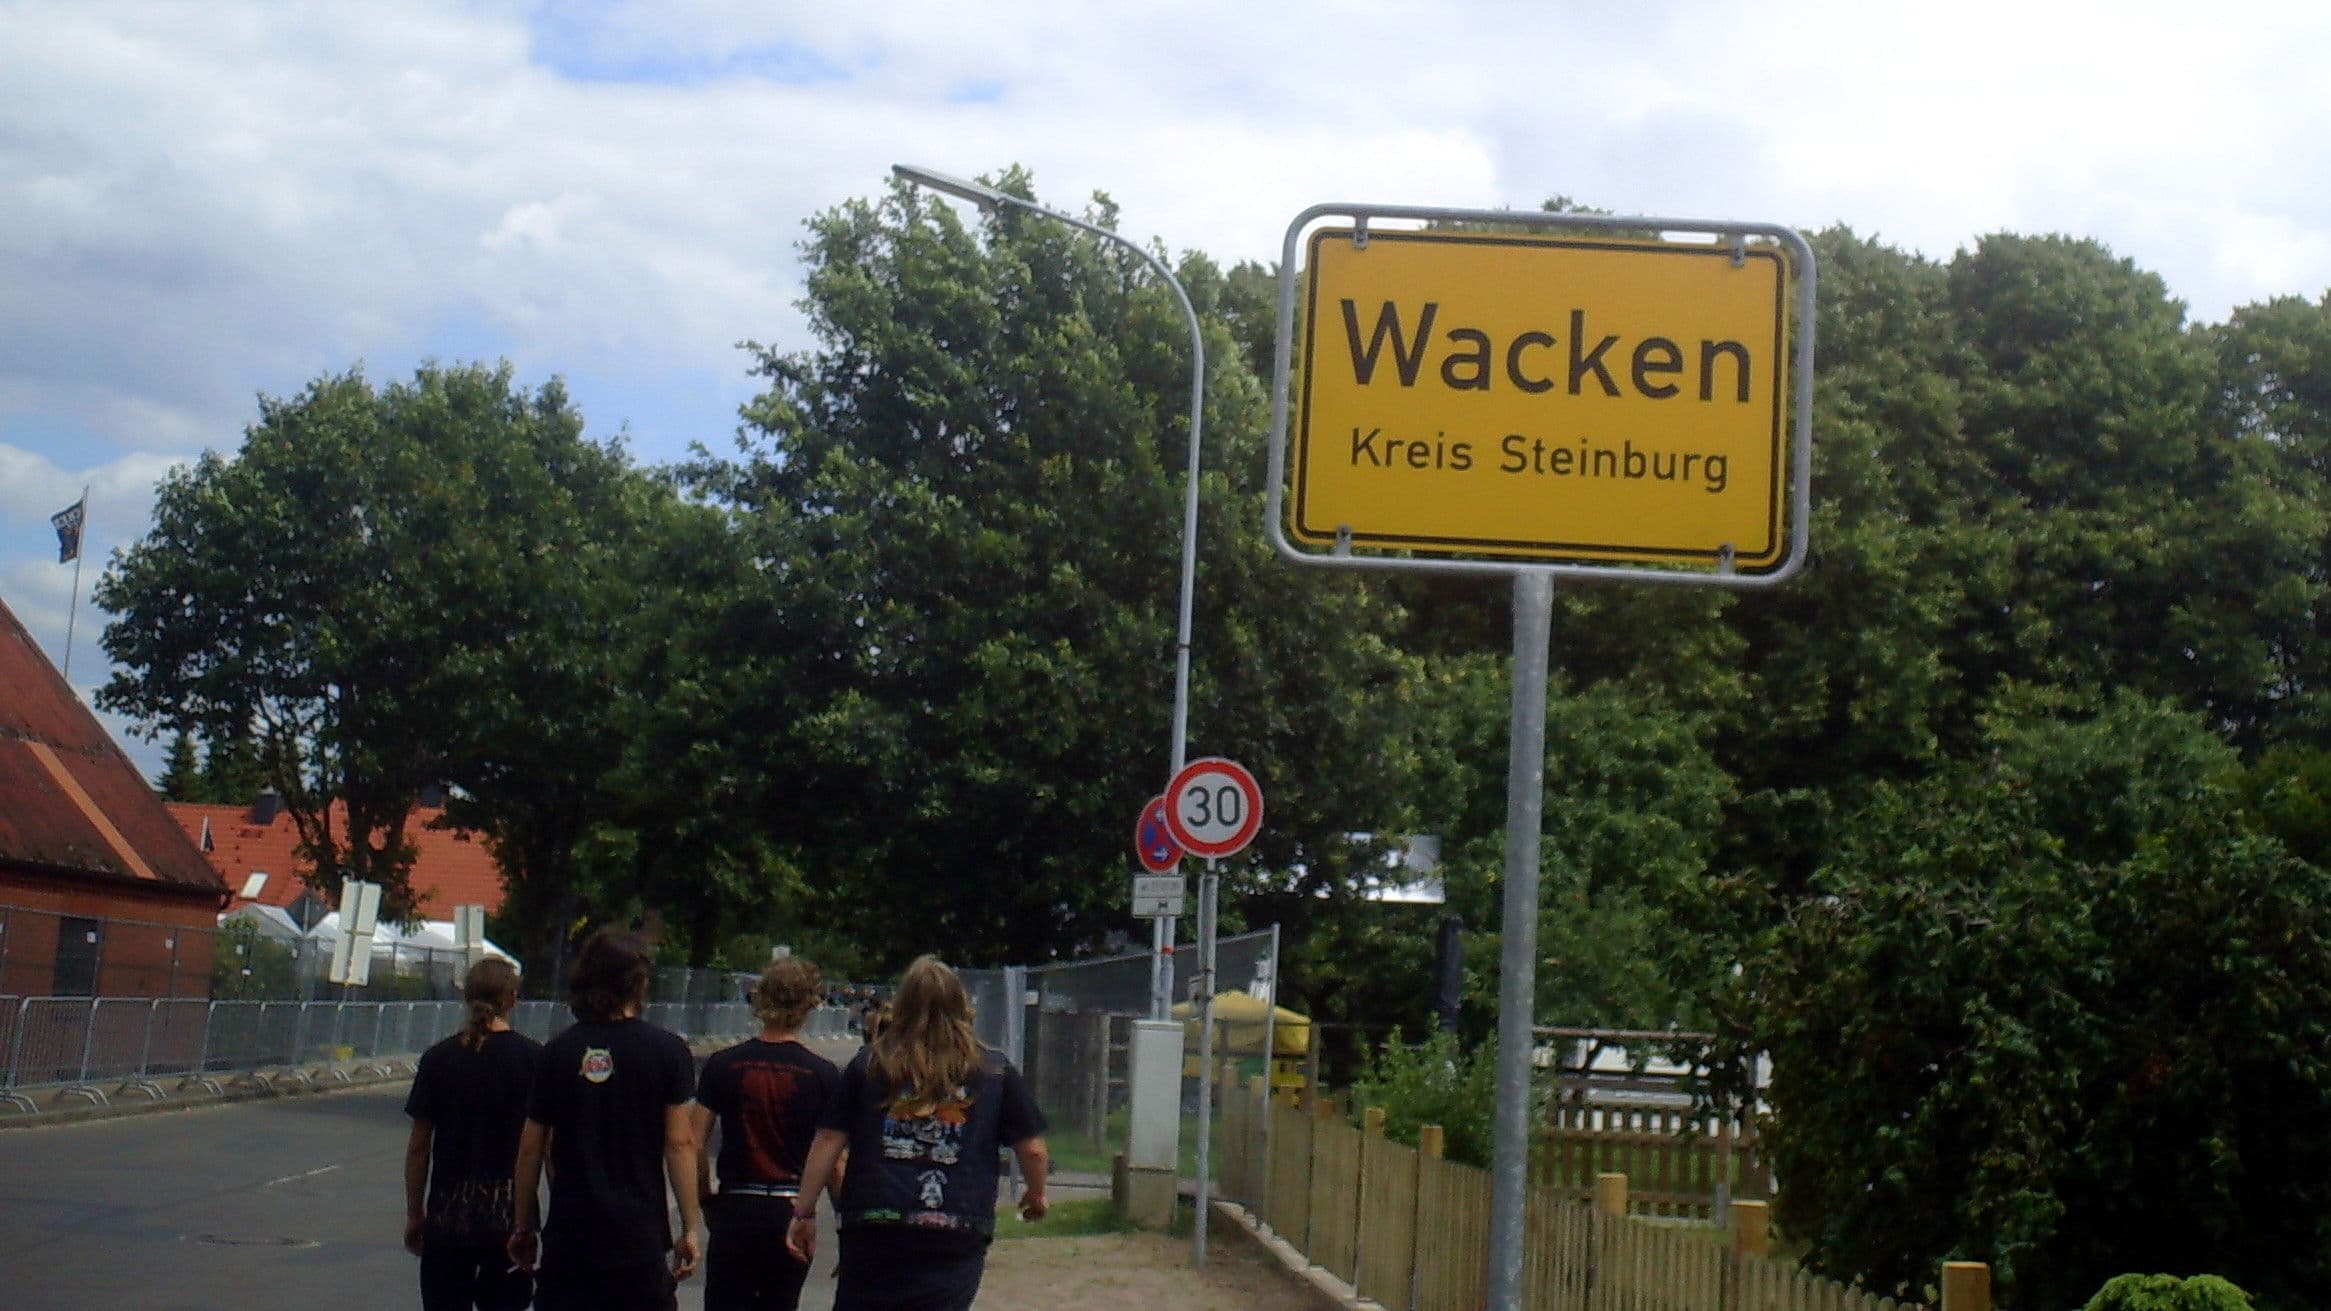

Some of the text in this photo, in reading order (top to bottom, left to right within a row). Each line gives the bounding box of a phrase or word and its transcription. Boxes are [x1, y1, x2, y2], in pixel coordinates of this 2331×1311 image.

[1340, 298, 1751, 404] Wacken
[1350, 427, 1728, 494] Kreis Steinburg
[1187, 786, 1241, 827] 30
